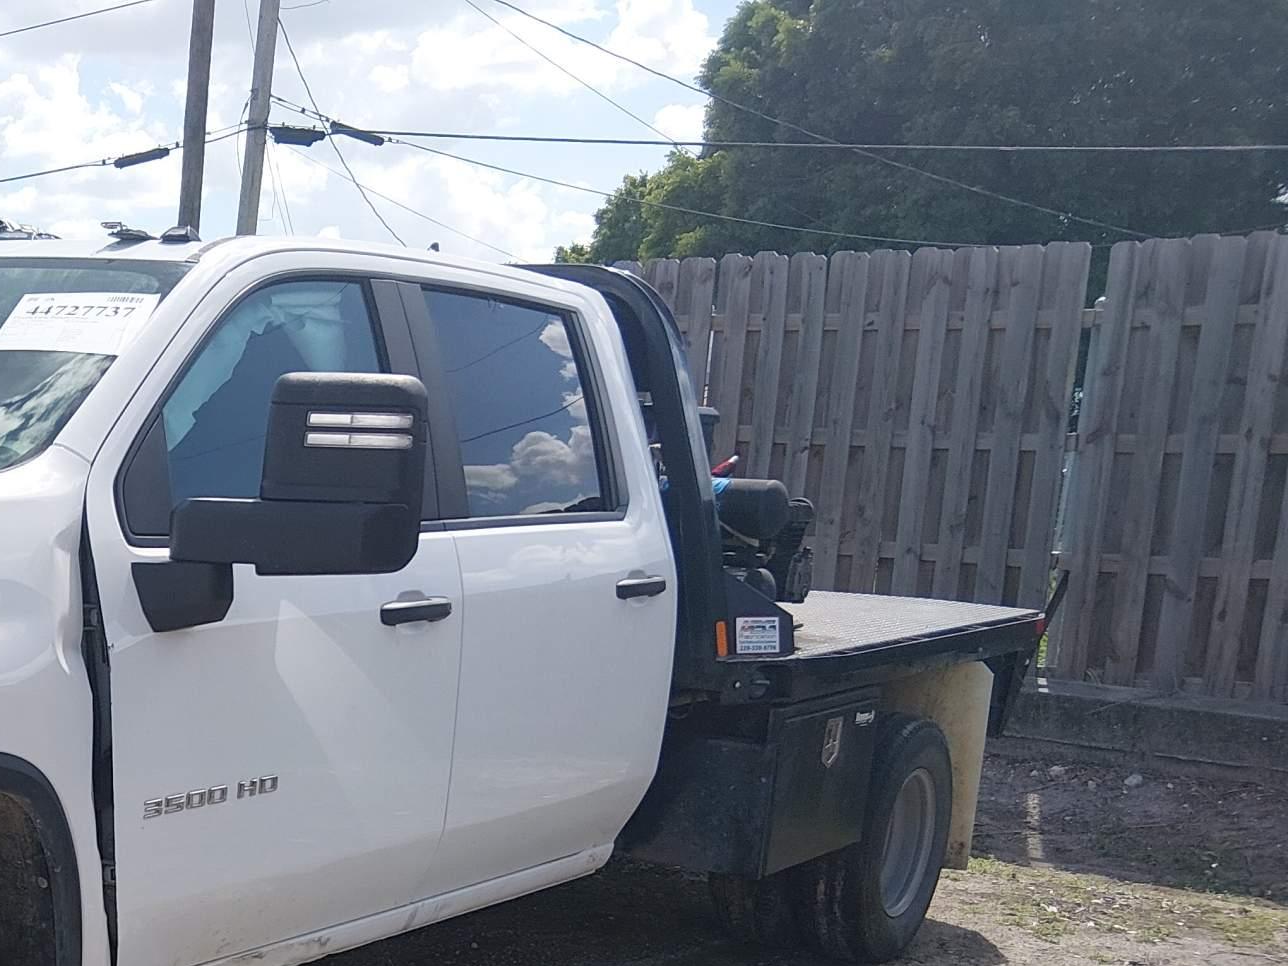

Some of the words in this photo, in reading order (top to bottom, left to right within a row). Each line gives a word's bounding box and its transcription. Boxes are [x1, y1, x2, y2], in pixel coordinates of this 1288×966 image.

[25, 305, 136, 318] 44727737
[143, 784, 228, 820] 3500
[237, 774, 278, 799] HD
